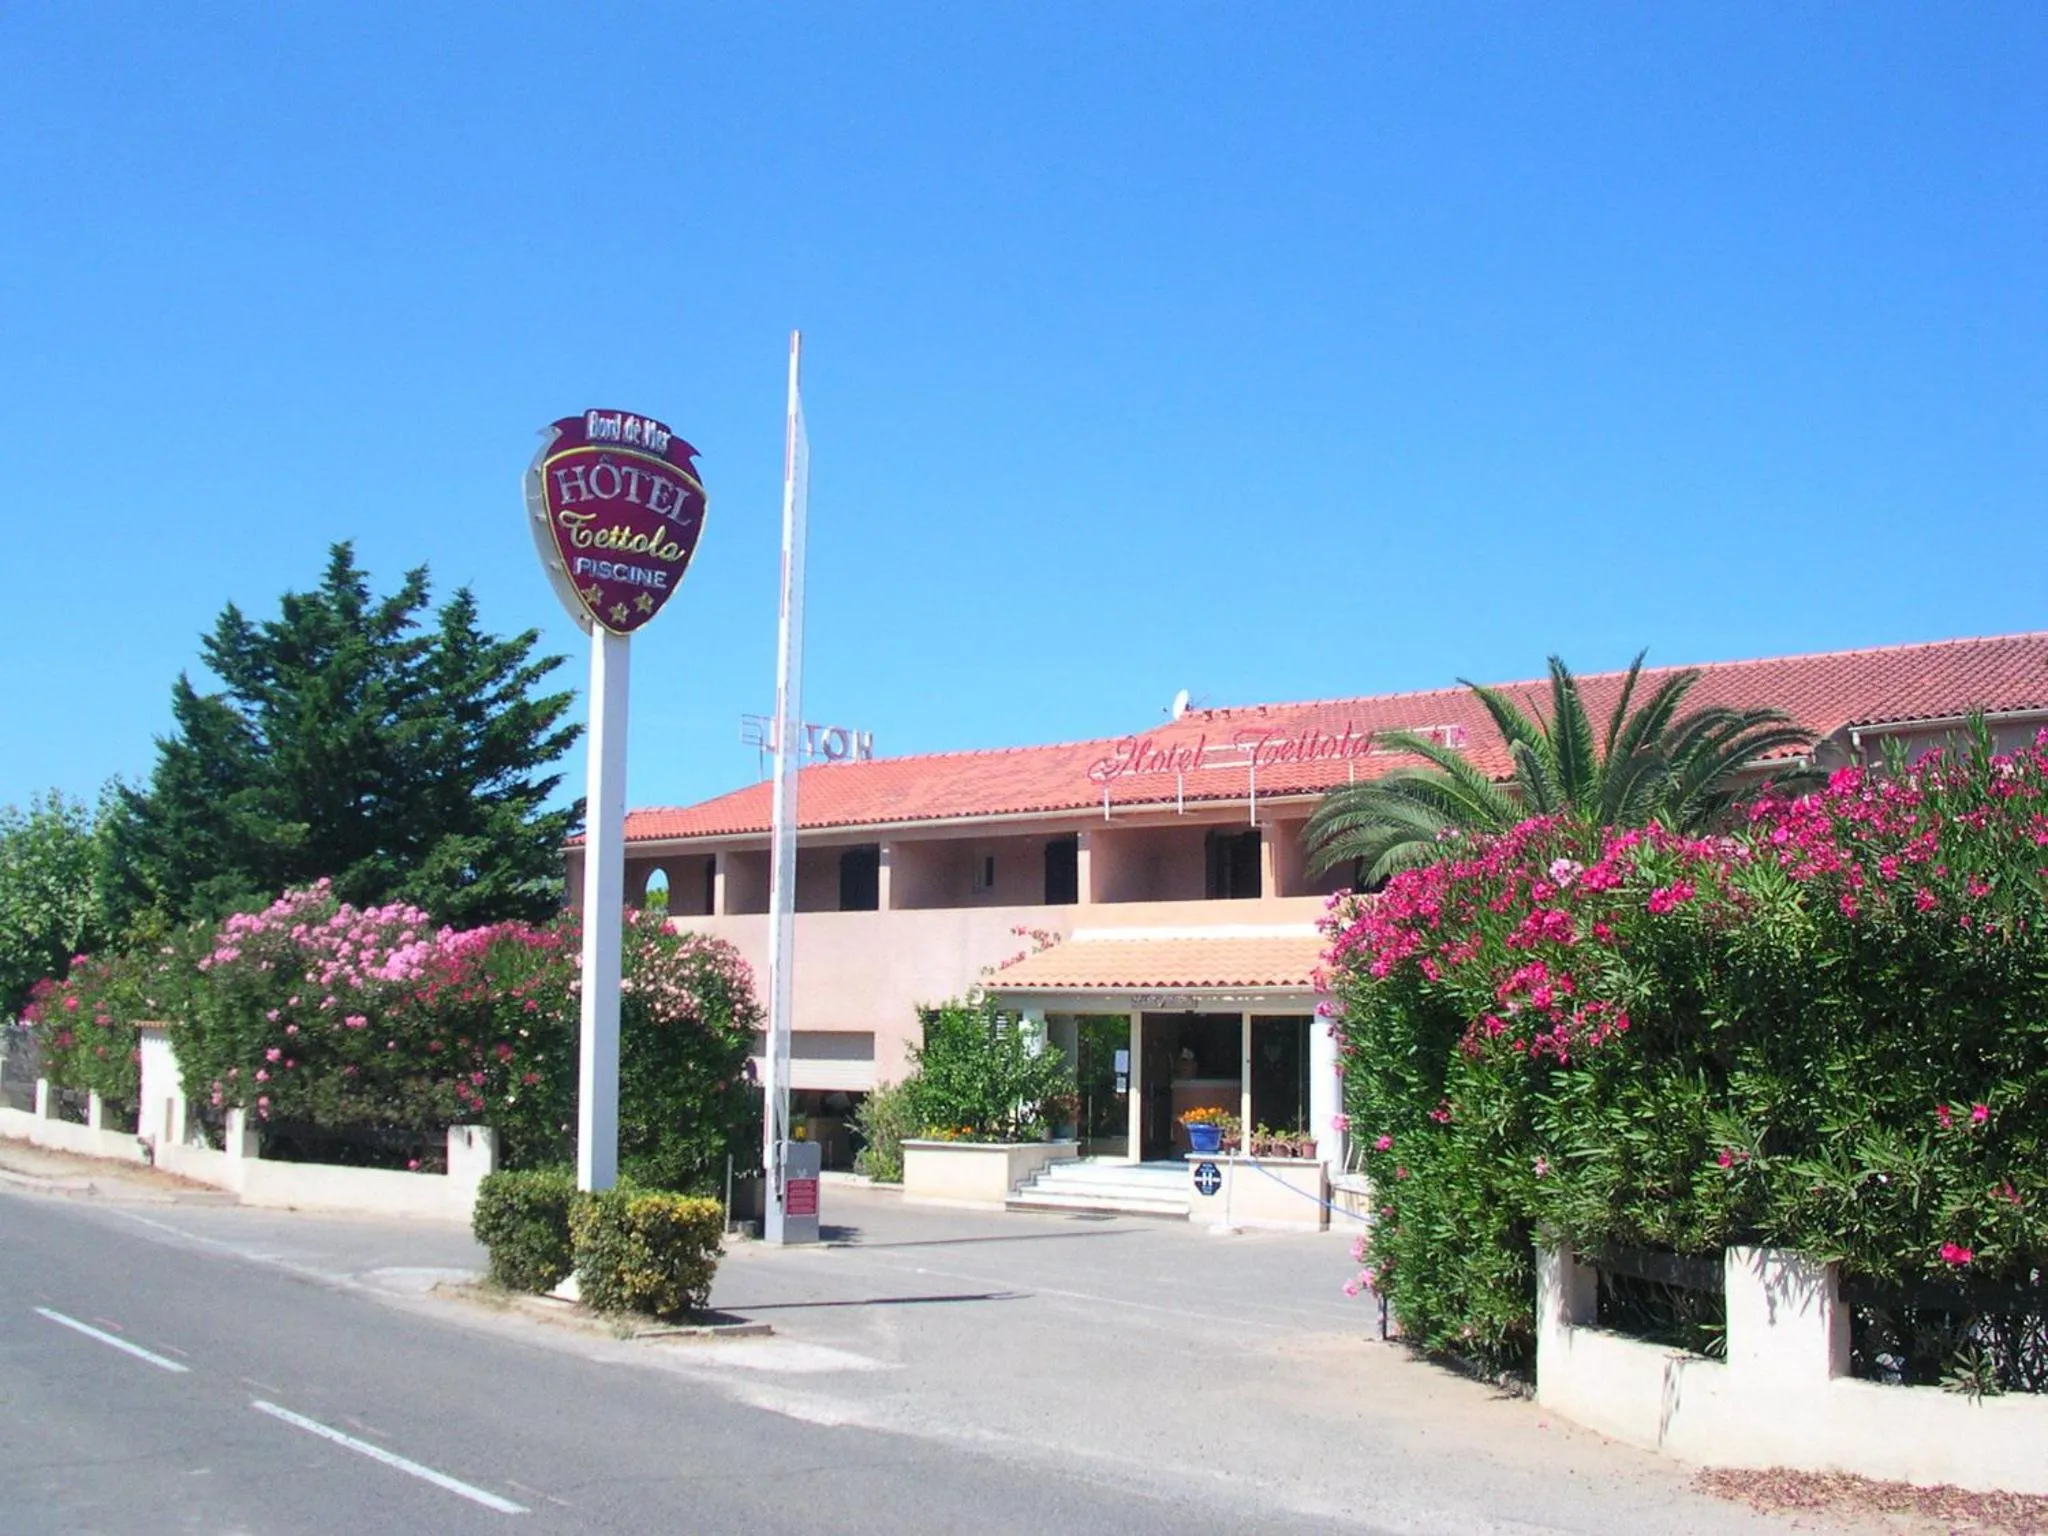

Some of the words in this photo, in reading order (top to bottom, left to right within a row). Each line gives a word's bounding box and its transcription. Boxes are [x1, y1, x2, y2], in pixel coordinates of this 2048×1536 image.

[586, 411, 622, 440] Bord
[624, 415, 641, 444] de
[642, 419, 671, 455] Mer
[558, 510, 686, 562] Tettola
[573, 556, 668, 589] PISCINE
[1087, 734, 1206, 785] Hotel
